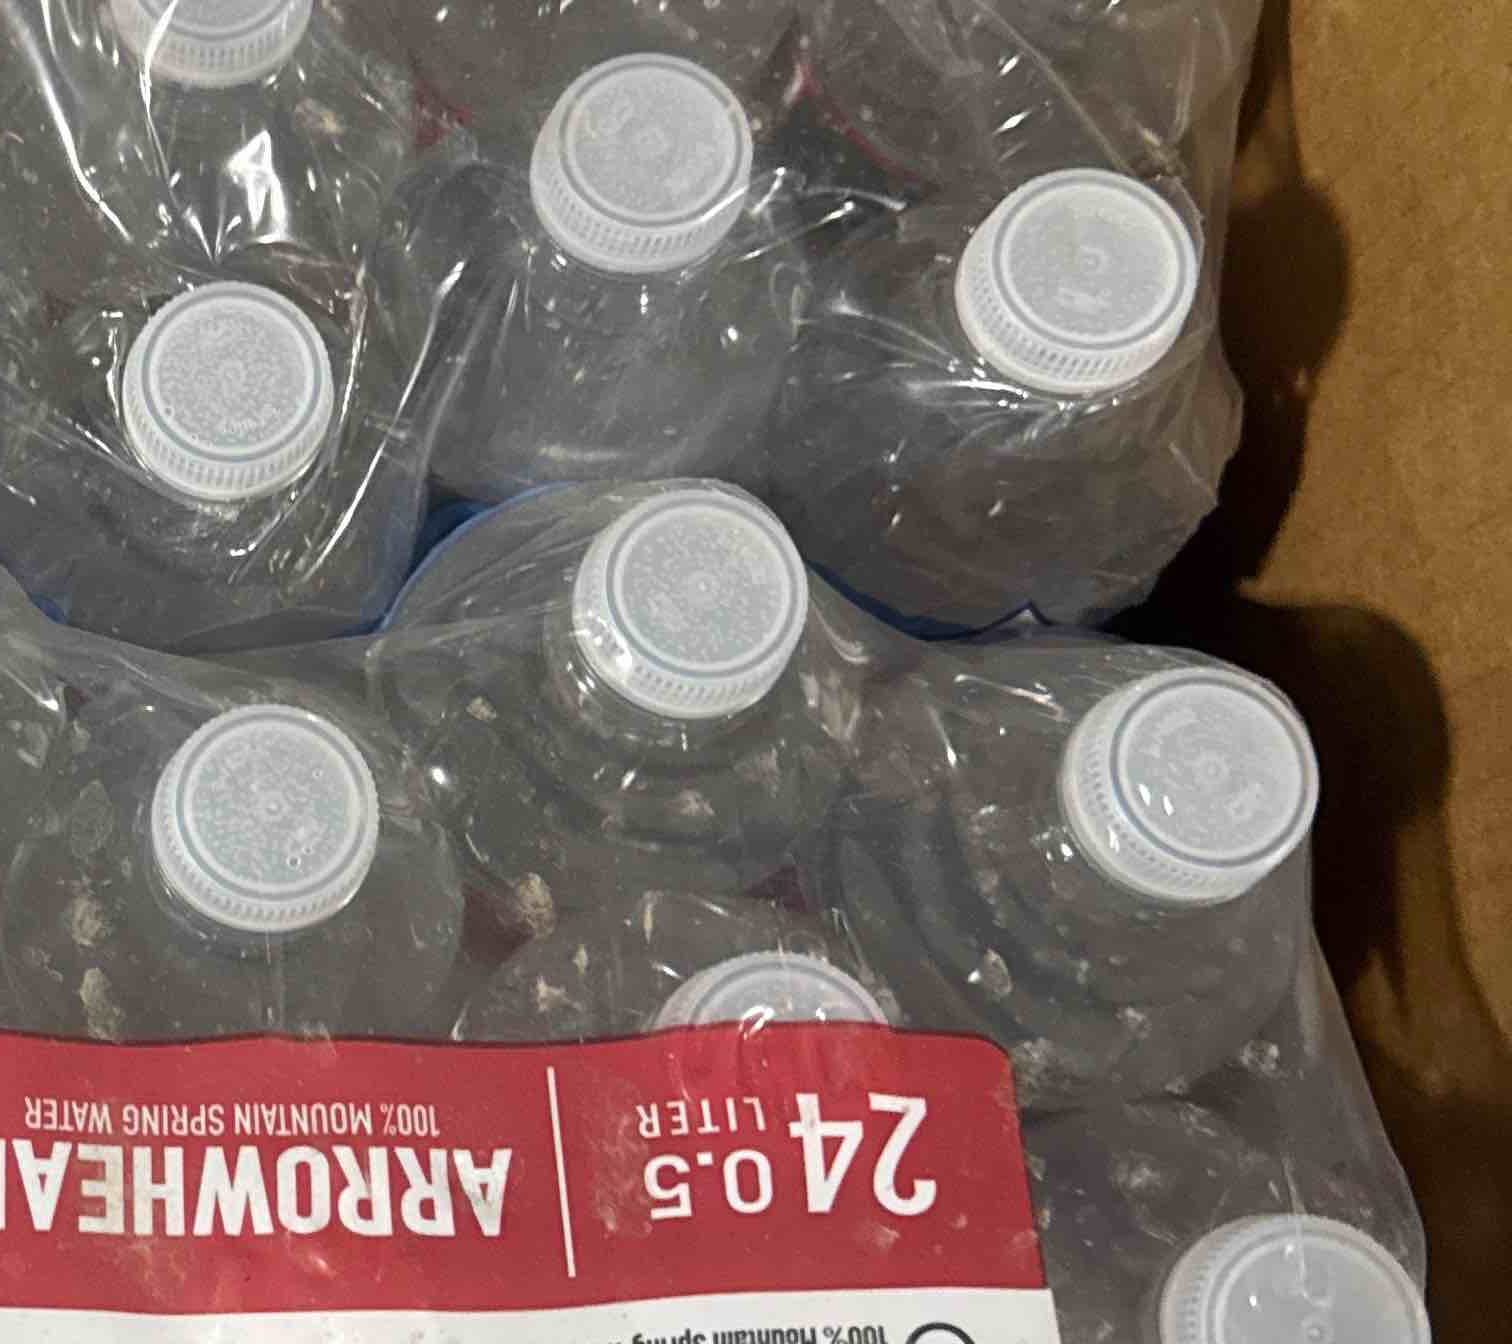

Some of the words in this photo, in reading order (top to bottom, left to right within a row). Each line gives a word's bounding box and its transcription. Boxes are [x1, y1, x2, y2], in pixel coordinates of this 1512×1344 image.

[24, 1095, 112, 1131] WATER
[121, 1102, 225, 1134] SPRING
[234, 1102, 372, 1136] MOUNTAIN
[379, 1102, 440, 1137] 100%
[635, 1095, 766, 1139] LITER
[788, 1092, 938, 1216] 24
[643, 1148, 774, 1220] 0.5
